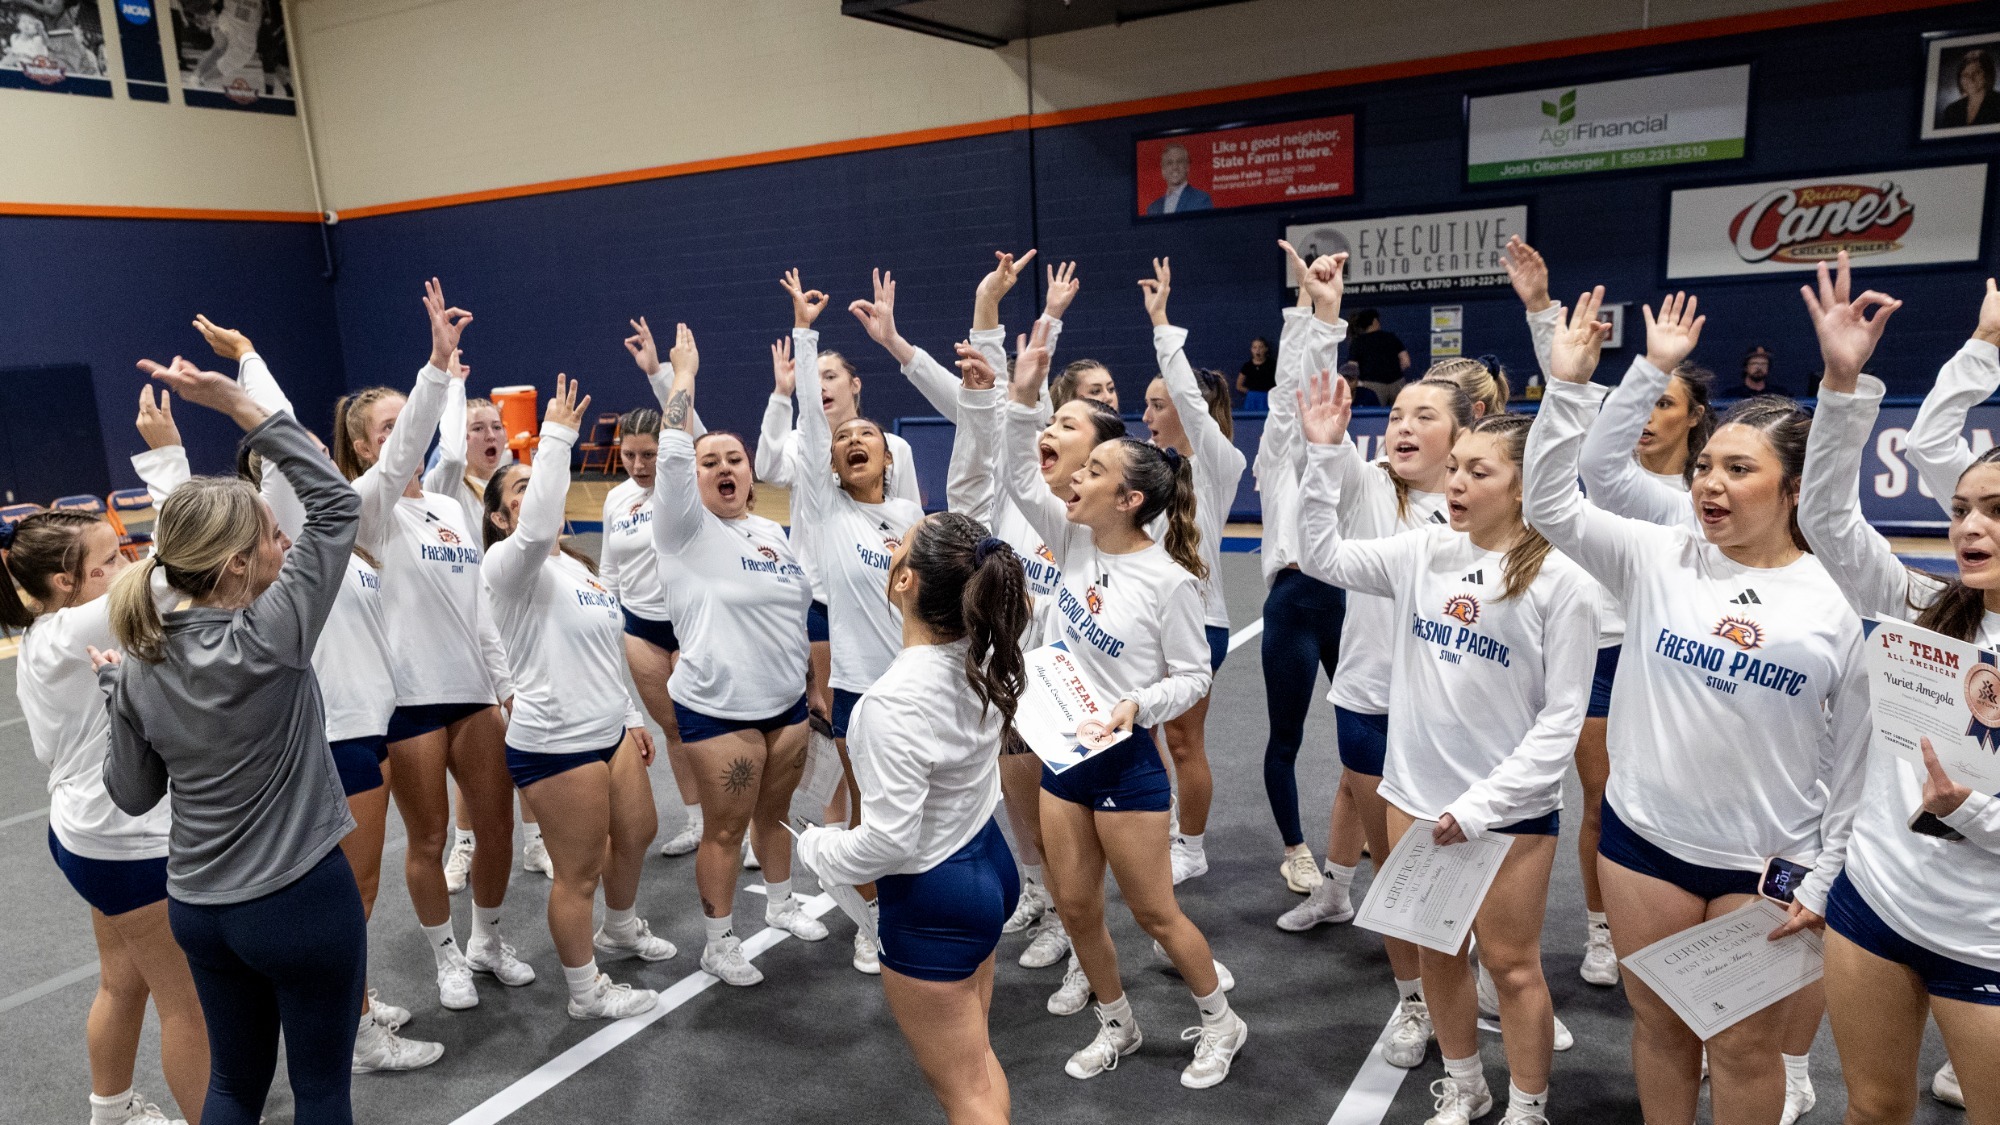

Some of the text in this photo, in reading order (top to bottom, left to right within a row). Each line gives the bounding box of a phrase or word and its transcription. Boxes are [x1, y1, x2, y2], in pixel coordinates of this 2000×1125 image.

[122, 4, 151, 17] NCAA
[1212, 129, 1341, 155] Like a good neighbor,
[1539, 113, 1668, 148] AgriFinancial
[1212, 156, 1244, 169] State
[1246, 152, 1280, 165] Farm
[1282, 149, 1293, 161] is
[1500, 164, 1530, 177] Josh
[1801, 187, 1862, 205] Raising
[1735, 180, 1915, 264] Cane's
[1358, 218, 1507, 260] EXECUTIVE
[1363, 250, 1501, 277] AUTO CENTER
[1361, 283, 1378, 293] Ave.
[1379, 280, 1410, 293] Fresno,
[1410, 280, 1426, 291] CA.
[421, 543, 456, 562] FRESNO
[741, 556, 778, 574] FRESNO
[1031, 582, 1050, 595] STUNT
[1058, 586, 1126, 659] RESNO PACIFIC
[1066, 625, 1082, 644] STUNT
[1439, 649, 1463, 665] STUNT
[1455, 627, 1511, 668] PACIFIC
[1881, 632, 1960, 670] 1ST TEAM
[1655, 628, 1808, 697] FRESNO PACIFIC
[1887, 652, 1957, 679] ALL-AMERICAN
[1055, 654, 1099, 715] 2ND TEAM
[1705, 675, 1739, 695] STUNT
[1883, 671, 1914, 692] Yuriet
[1915, 682, 1955, 707] Amezola
[1384, 841, 1428, 909] CERTIFICATE
[1777, 870, 1791, 892] 4:01
[1664, 920, 1755, 965] CERTIFICATE
